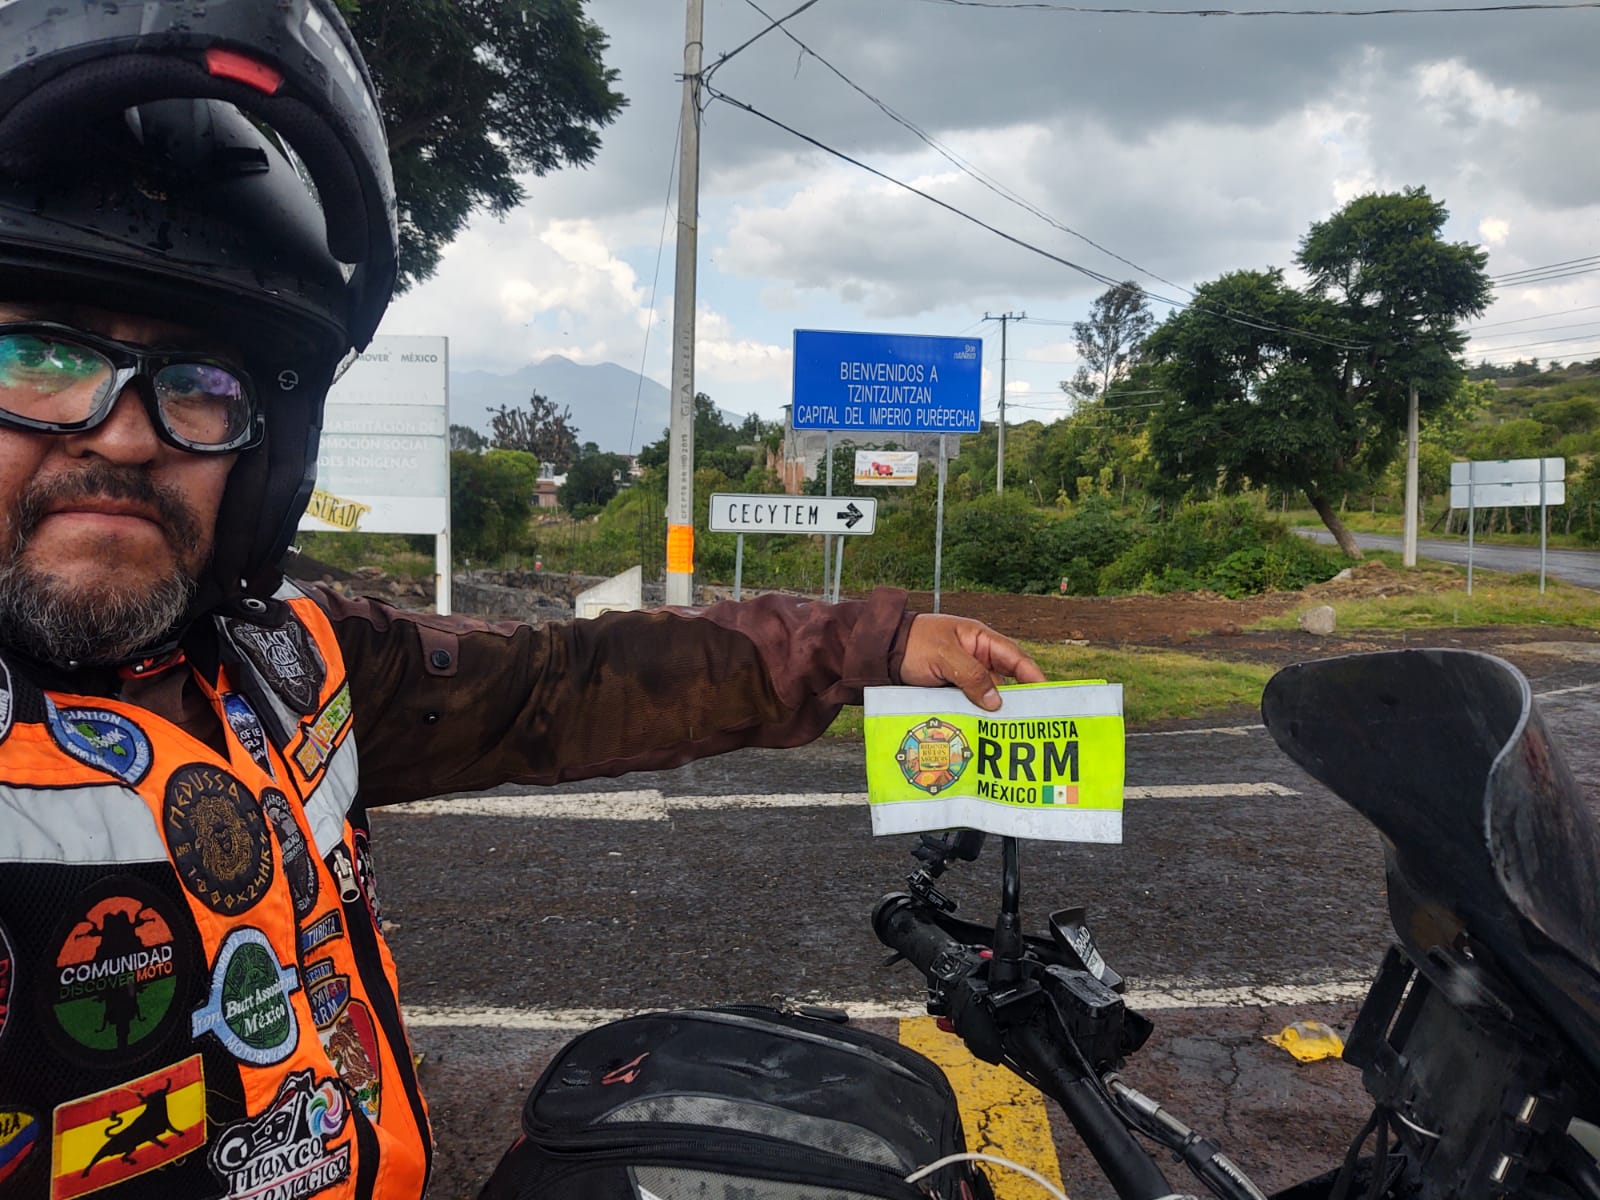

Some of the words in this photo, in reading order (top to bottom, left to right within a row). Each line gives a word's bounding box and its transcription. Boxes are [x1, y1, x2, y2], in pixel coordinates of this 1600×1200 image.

[400, 351, 438, 363] MÉXICO
[840, 362, 924, 383] BIENVENIDOS
[929, 365, 938, 383] A
[848, 384, 932, 404] TZINTZUNTZAN
[797, 405, 840, 425] CAPITAL
[845, 406, 865, 425] DEL
[869, 407, 912, 426] IMPERIO
[916, 405, 976, 427] PURÉPECHA
[383, 439, 432, 450] SOCIAL
[347, 454, 418, 468] INDÍGENAS
[728, 503, 820, 526] CECYTEM
[251, 630, 301, 665] BLACK
[977, 719, 1079, 740] MOTOTURISTA
[977, 737, 1080, 782] RRM
[977, 780, 1037, 804] MÉXICO
[60, 945, 173, 985] COMUNIDAD
[225, 995, 254, 1020] Butt
[244, 1003, 286, 1037] México
